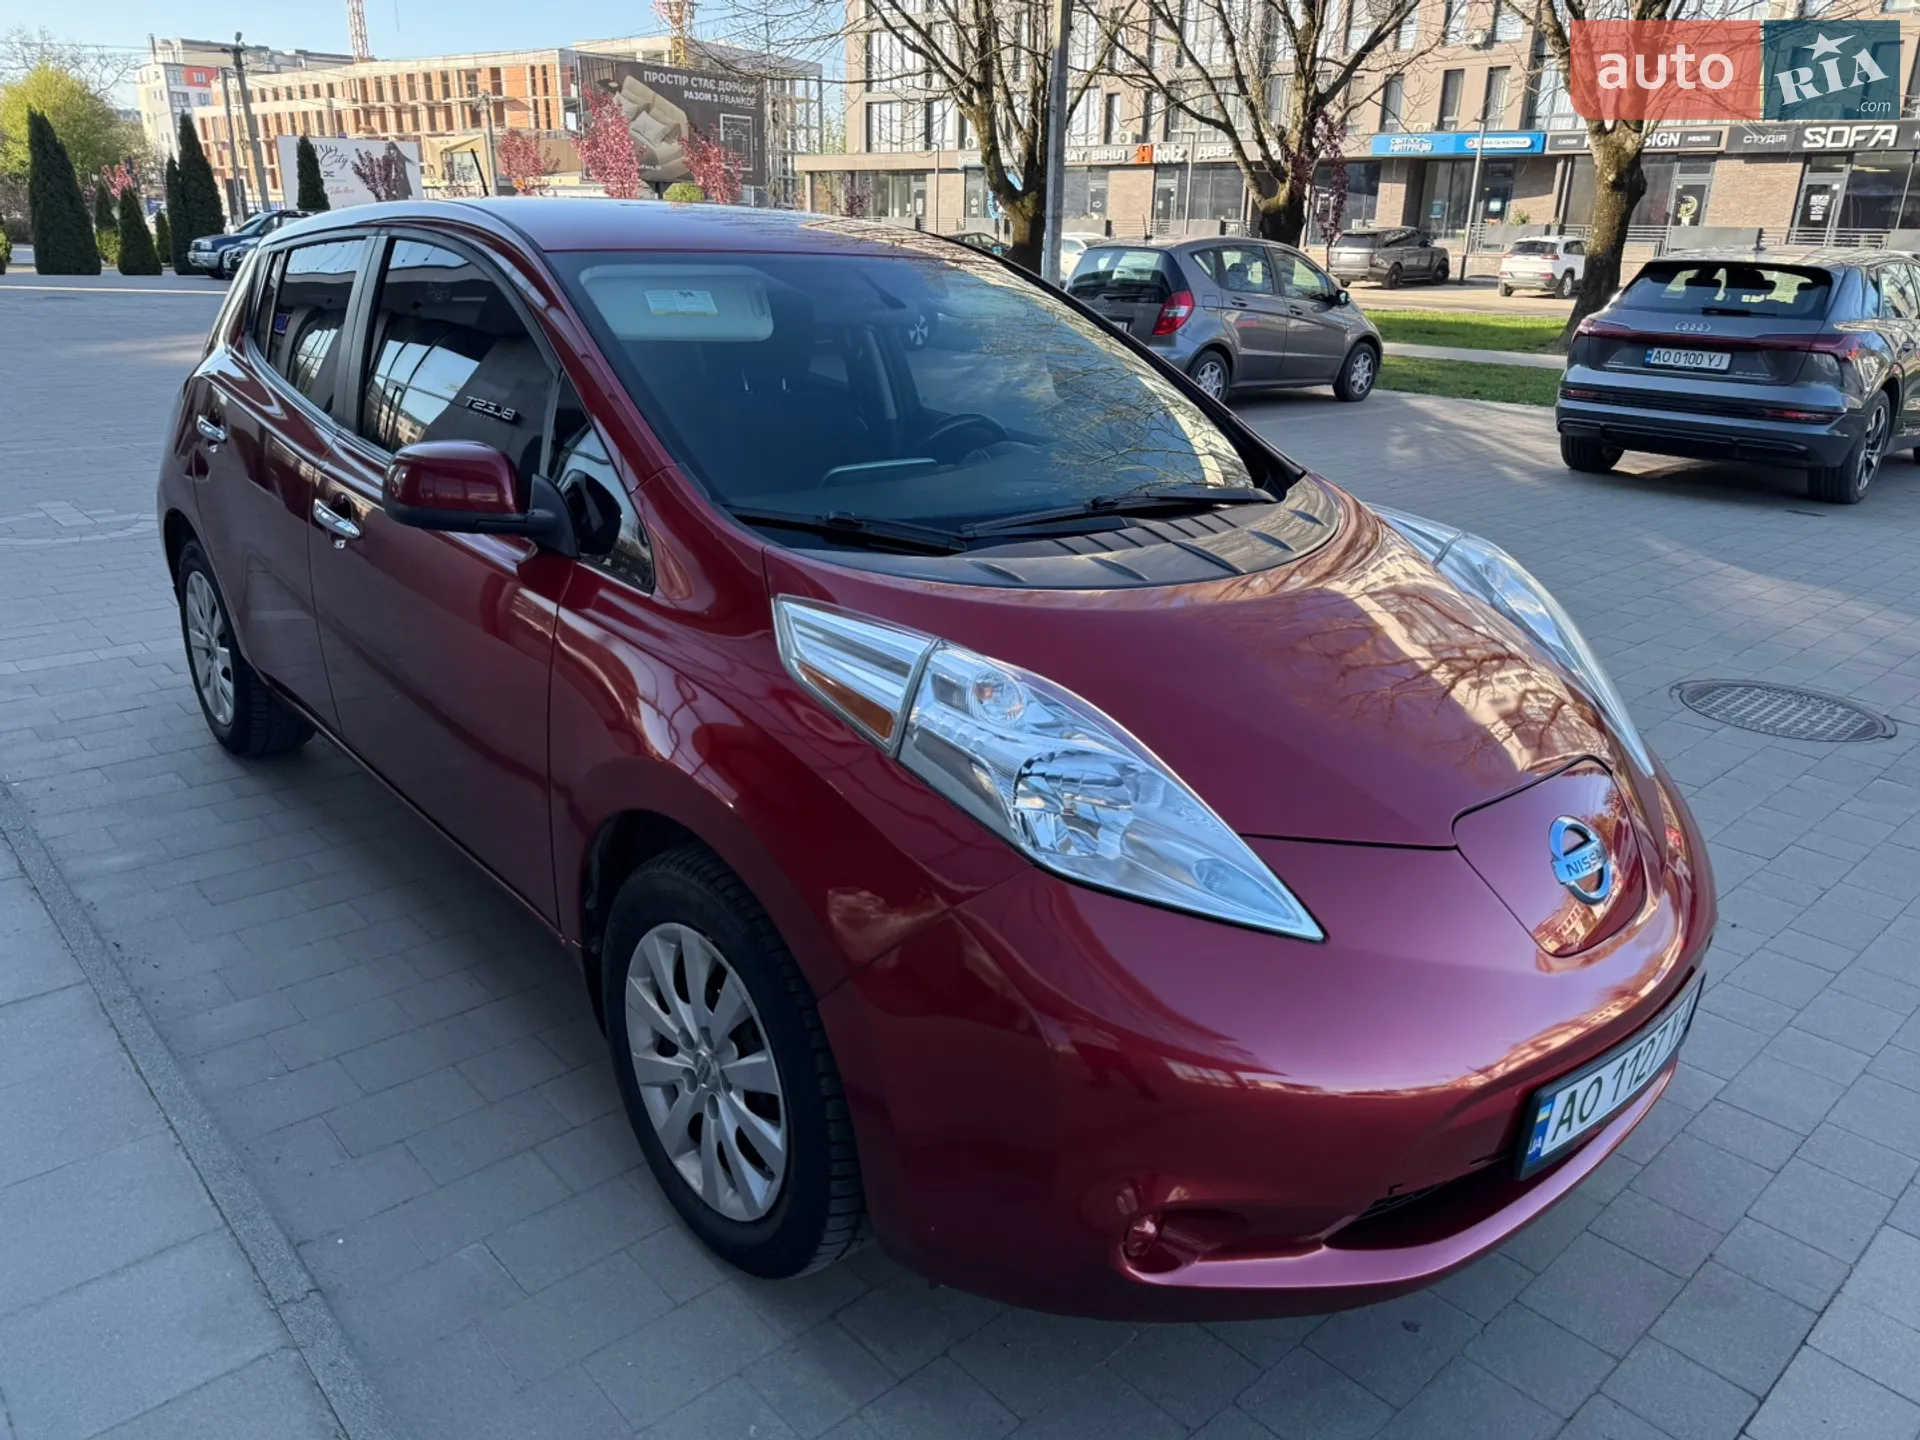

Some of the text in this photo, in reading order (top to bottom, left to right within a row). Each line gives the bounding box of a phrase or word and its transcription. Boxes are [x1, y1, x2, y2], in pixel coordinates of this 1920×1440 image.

[644, 71, 690, 87] ПРОСТІР
[691, 76, 716, 90] СТАЄ
[684, 90, 712, 102] РАЗОМ
[1743, 134, 1788, 144] СТУДІЯ
[1802, 124, 1899, 149] SOFA
[1153, 144, 1186, 164] holz
[1197, 145, 1234, 159] ДВЕР
[1653, 350, 1725, 367] AO 0100 YJ
[1551, 1076, 1603, 1142] AO
[1612, 1026, 1669, 1102] 1127
